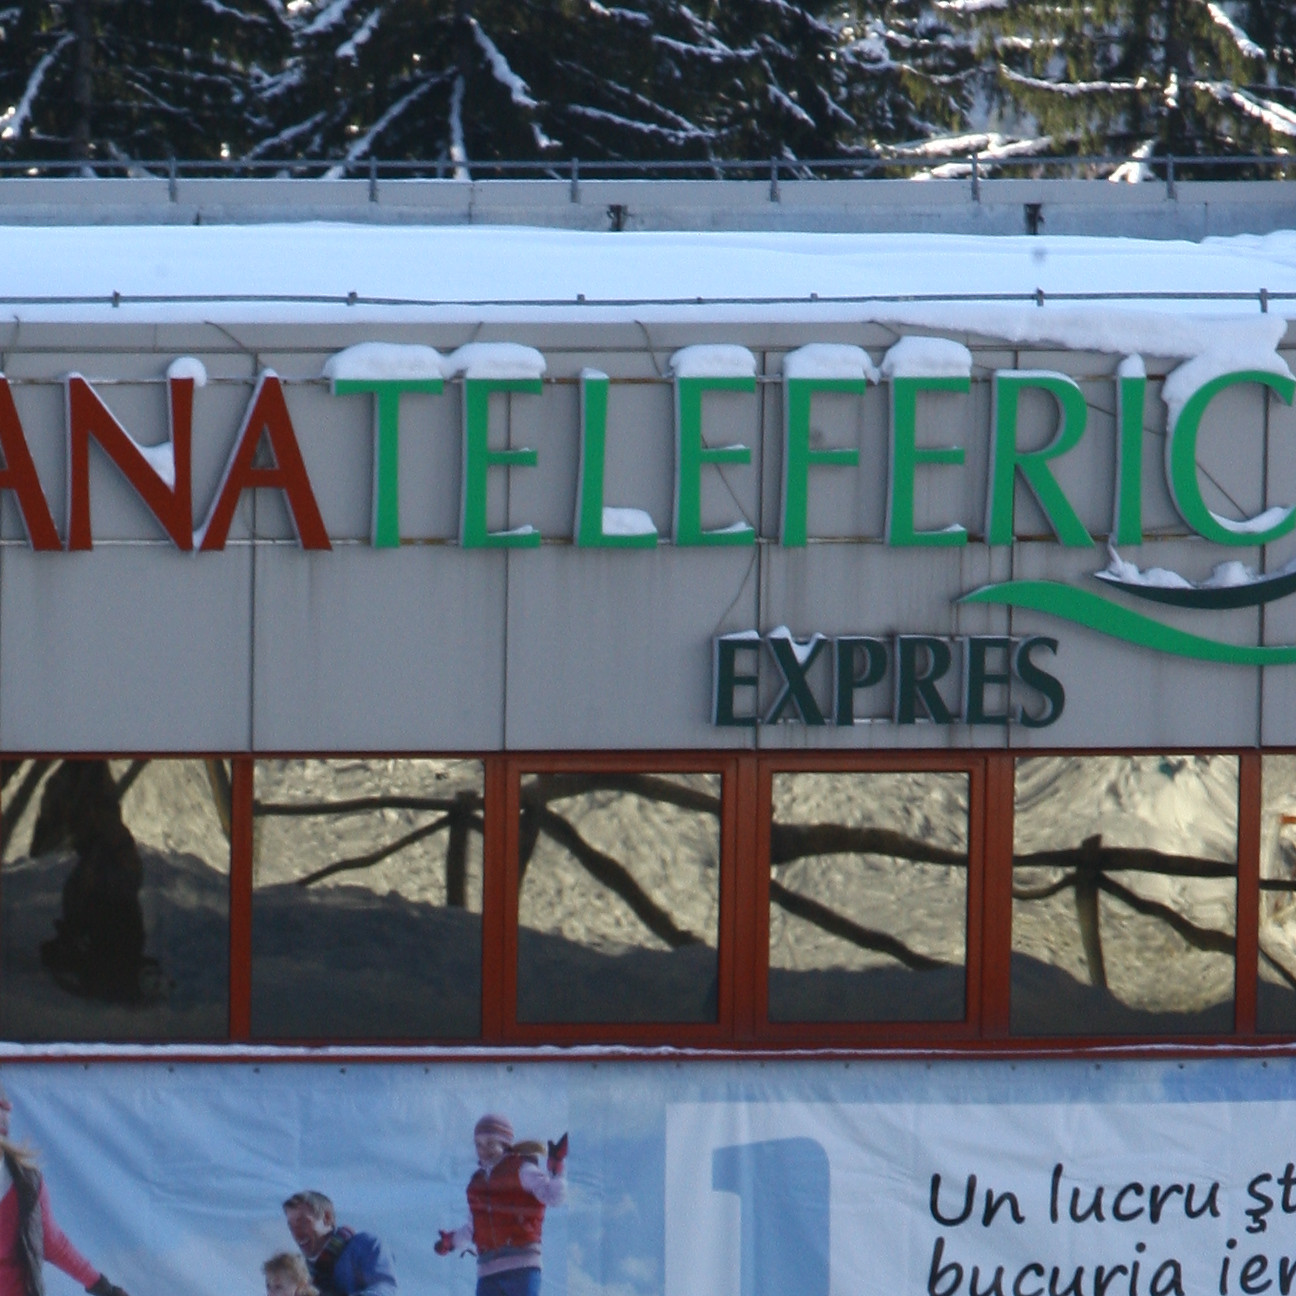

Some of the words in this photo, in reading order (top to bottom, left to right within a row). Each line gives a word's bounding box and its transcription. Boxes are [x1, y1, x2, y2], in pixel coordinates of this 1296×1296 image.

[713, 634, 1068, 729] EXPRES
[930, 1173, 1025, 1228] Un
[1049, 1163, 1221, 1226] lucru
